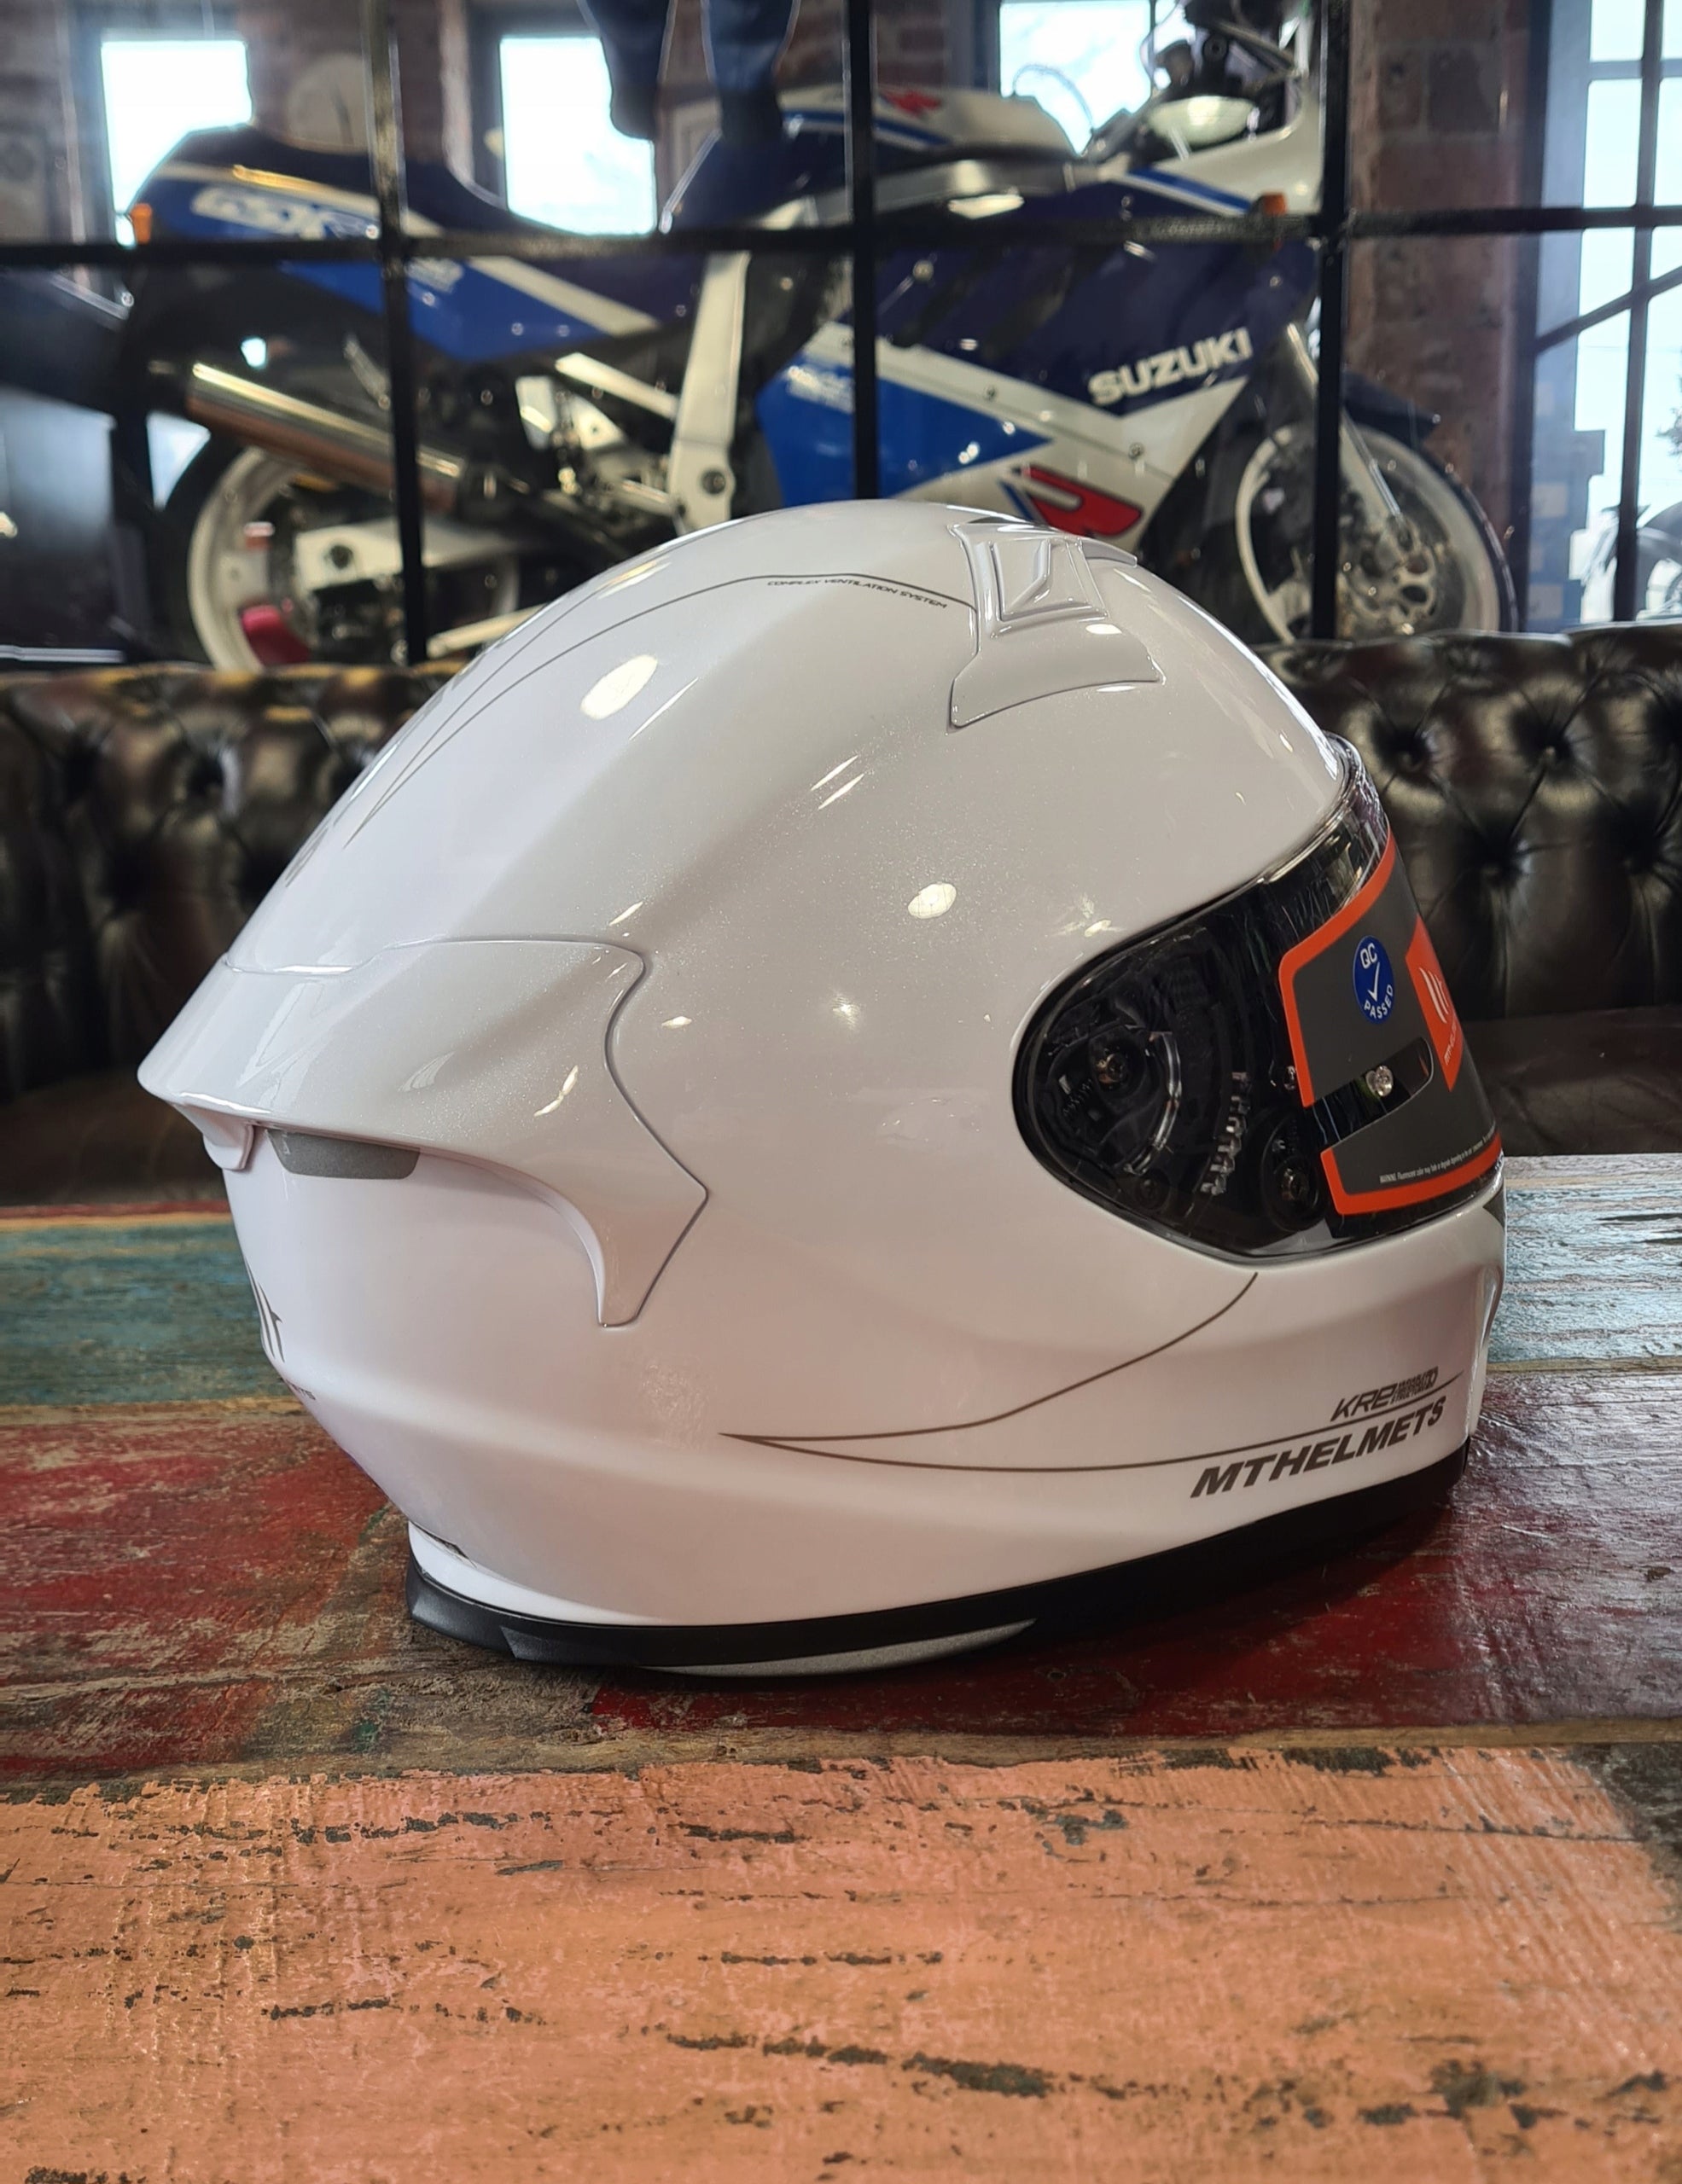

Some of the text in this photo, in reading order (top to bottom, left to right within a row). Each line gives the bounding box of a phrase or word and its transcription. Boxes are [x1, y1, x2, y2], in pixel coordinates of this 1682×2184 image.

[1088, 327, 1253, 406] SUZUKI
[824, 578, 898, 595] VENTILATION
[900, 591, 948, 609] SYSTEM
[1359, 943, 1377, 969] QC
[1364, 985, 1394, 1019] PASSED
